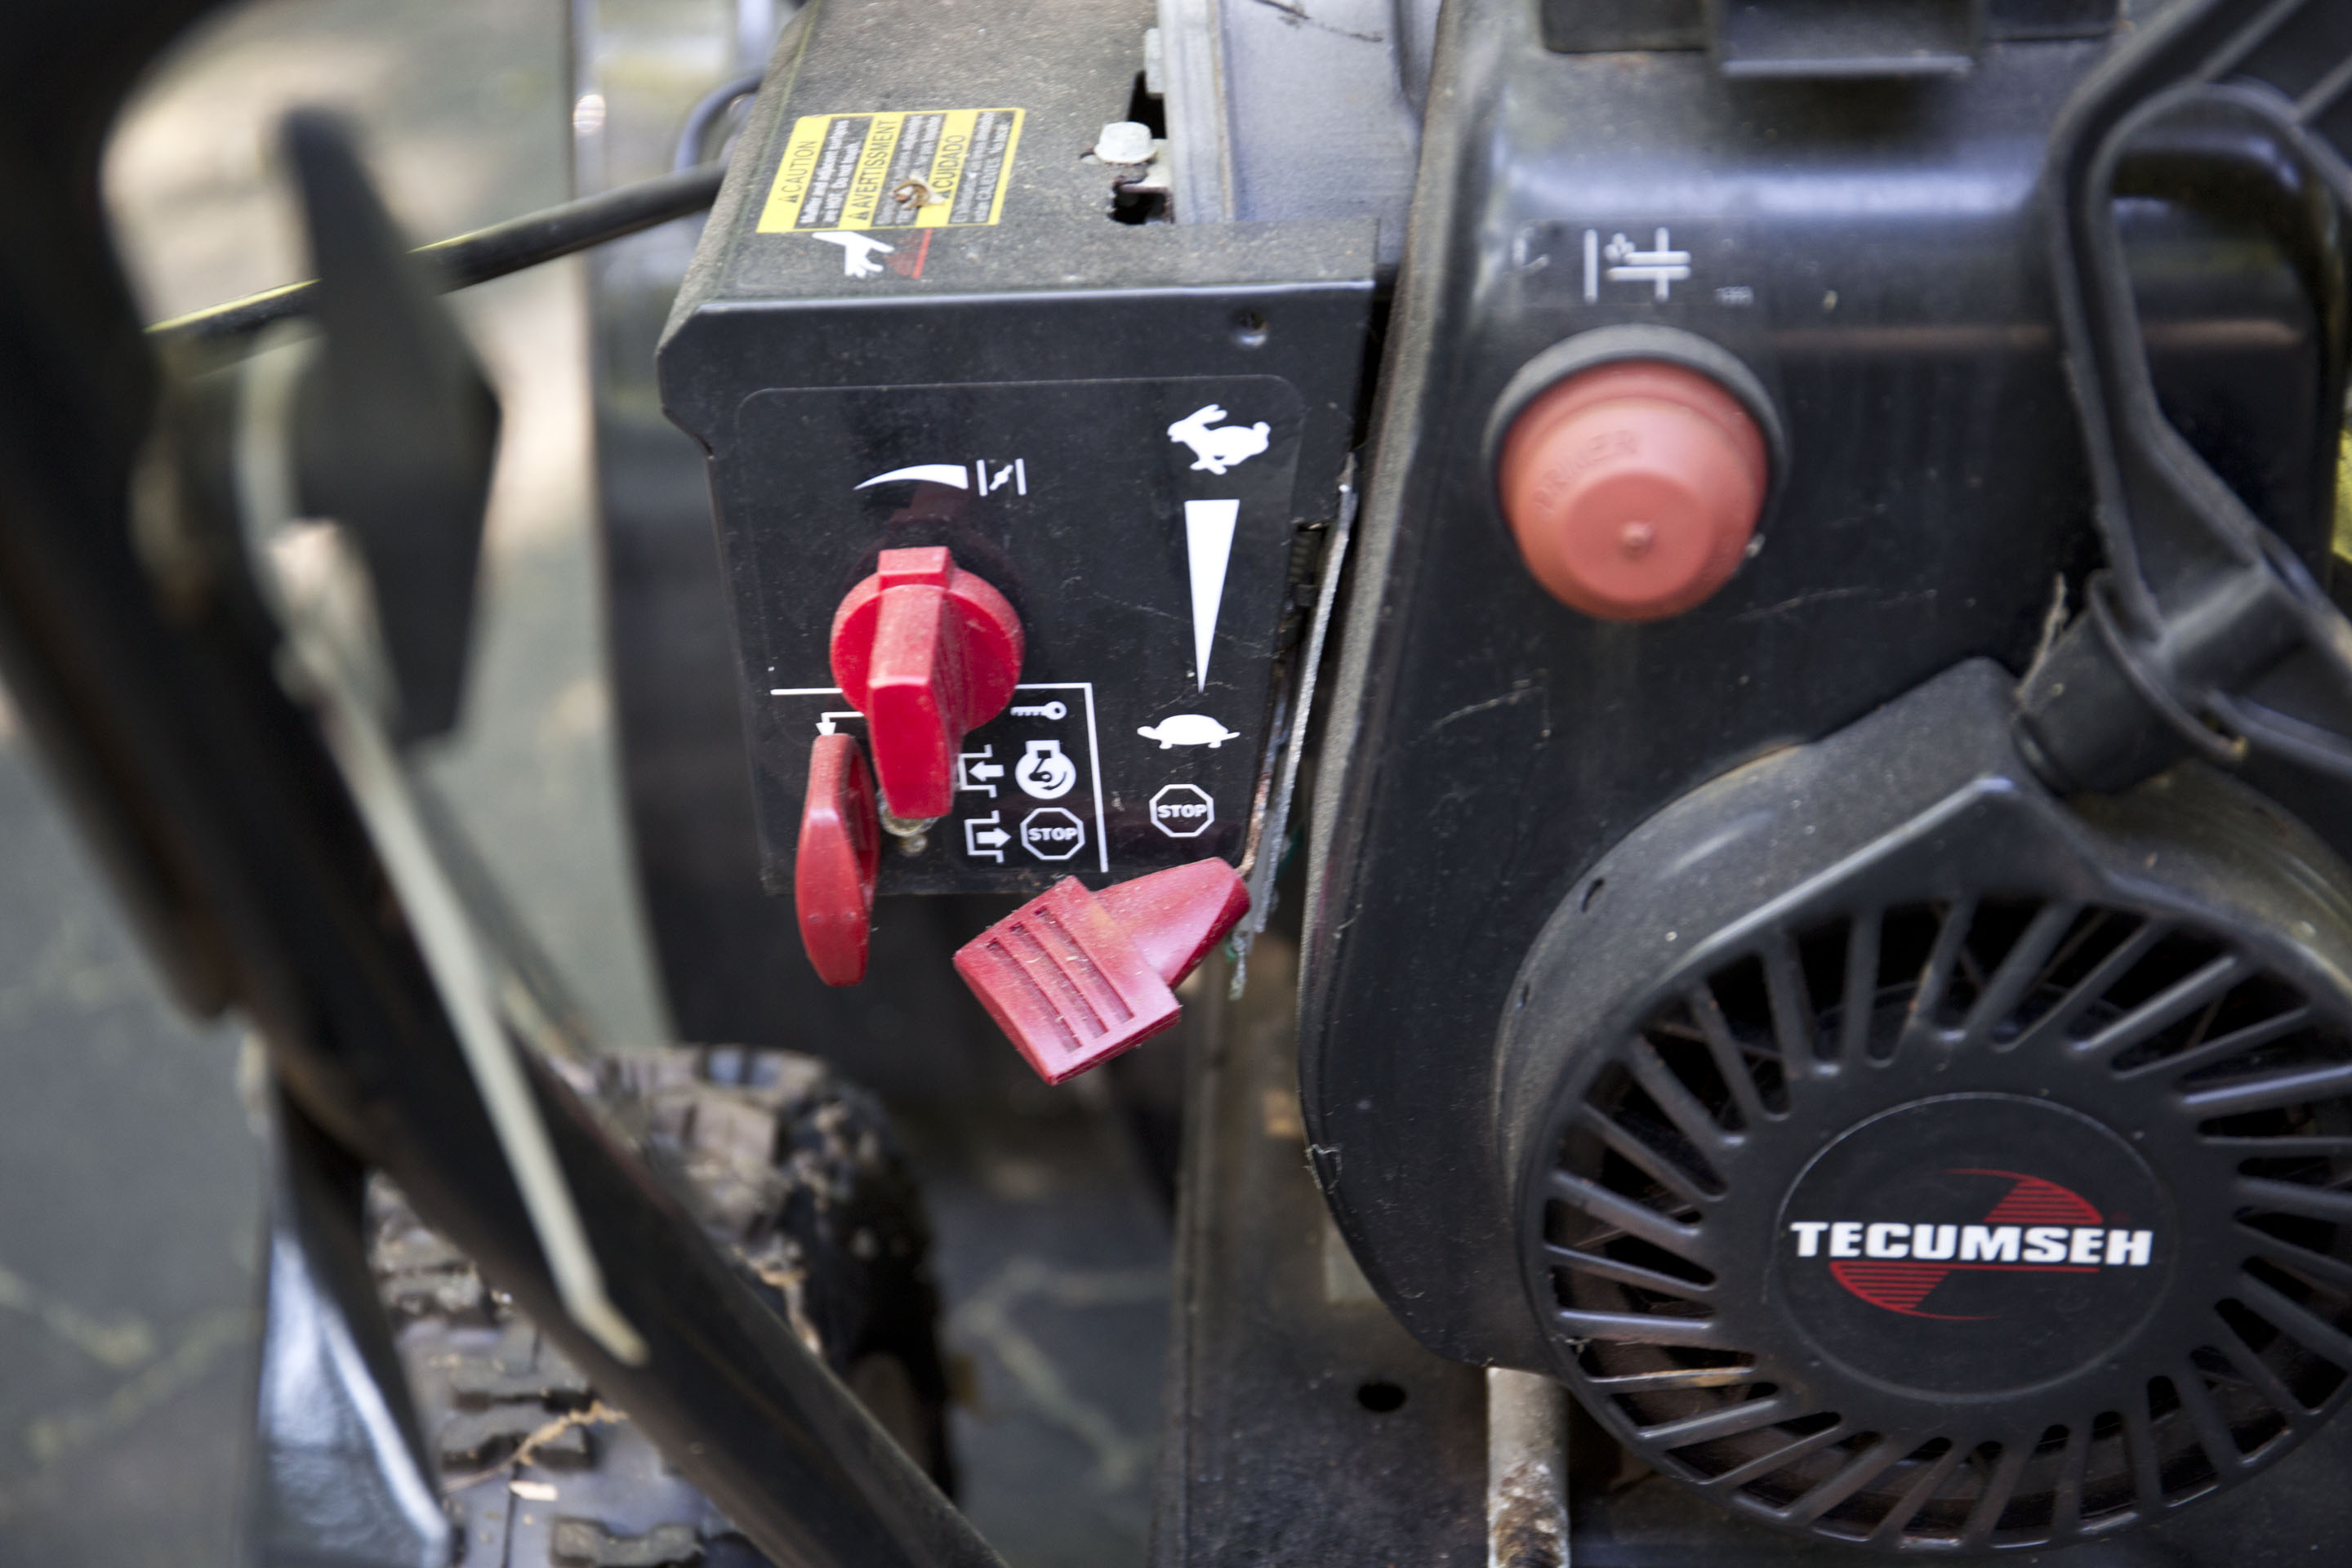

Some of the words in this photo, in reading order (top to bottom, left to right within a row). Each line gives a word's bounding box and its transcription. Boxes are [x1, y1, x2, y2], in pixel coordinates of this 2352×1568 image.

[781, 140, 818, 192] CAUTION
[855, 119, 898, 209] AVERTISSMENT
[931, 135, 965, 188] CUIDADO
[1027, 826, 1077, 842] STOP
[1157, 804, 1207, 818] STOP
[1788, 1221, 2154, 1267] TECUMSEH
